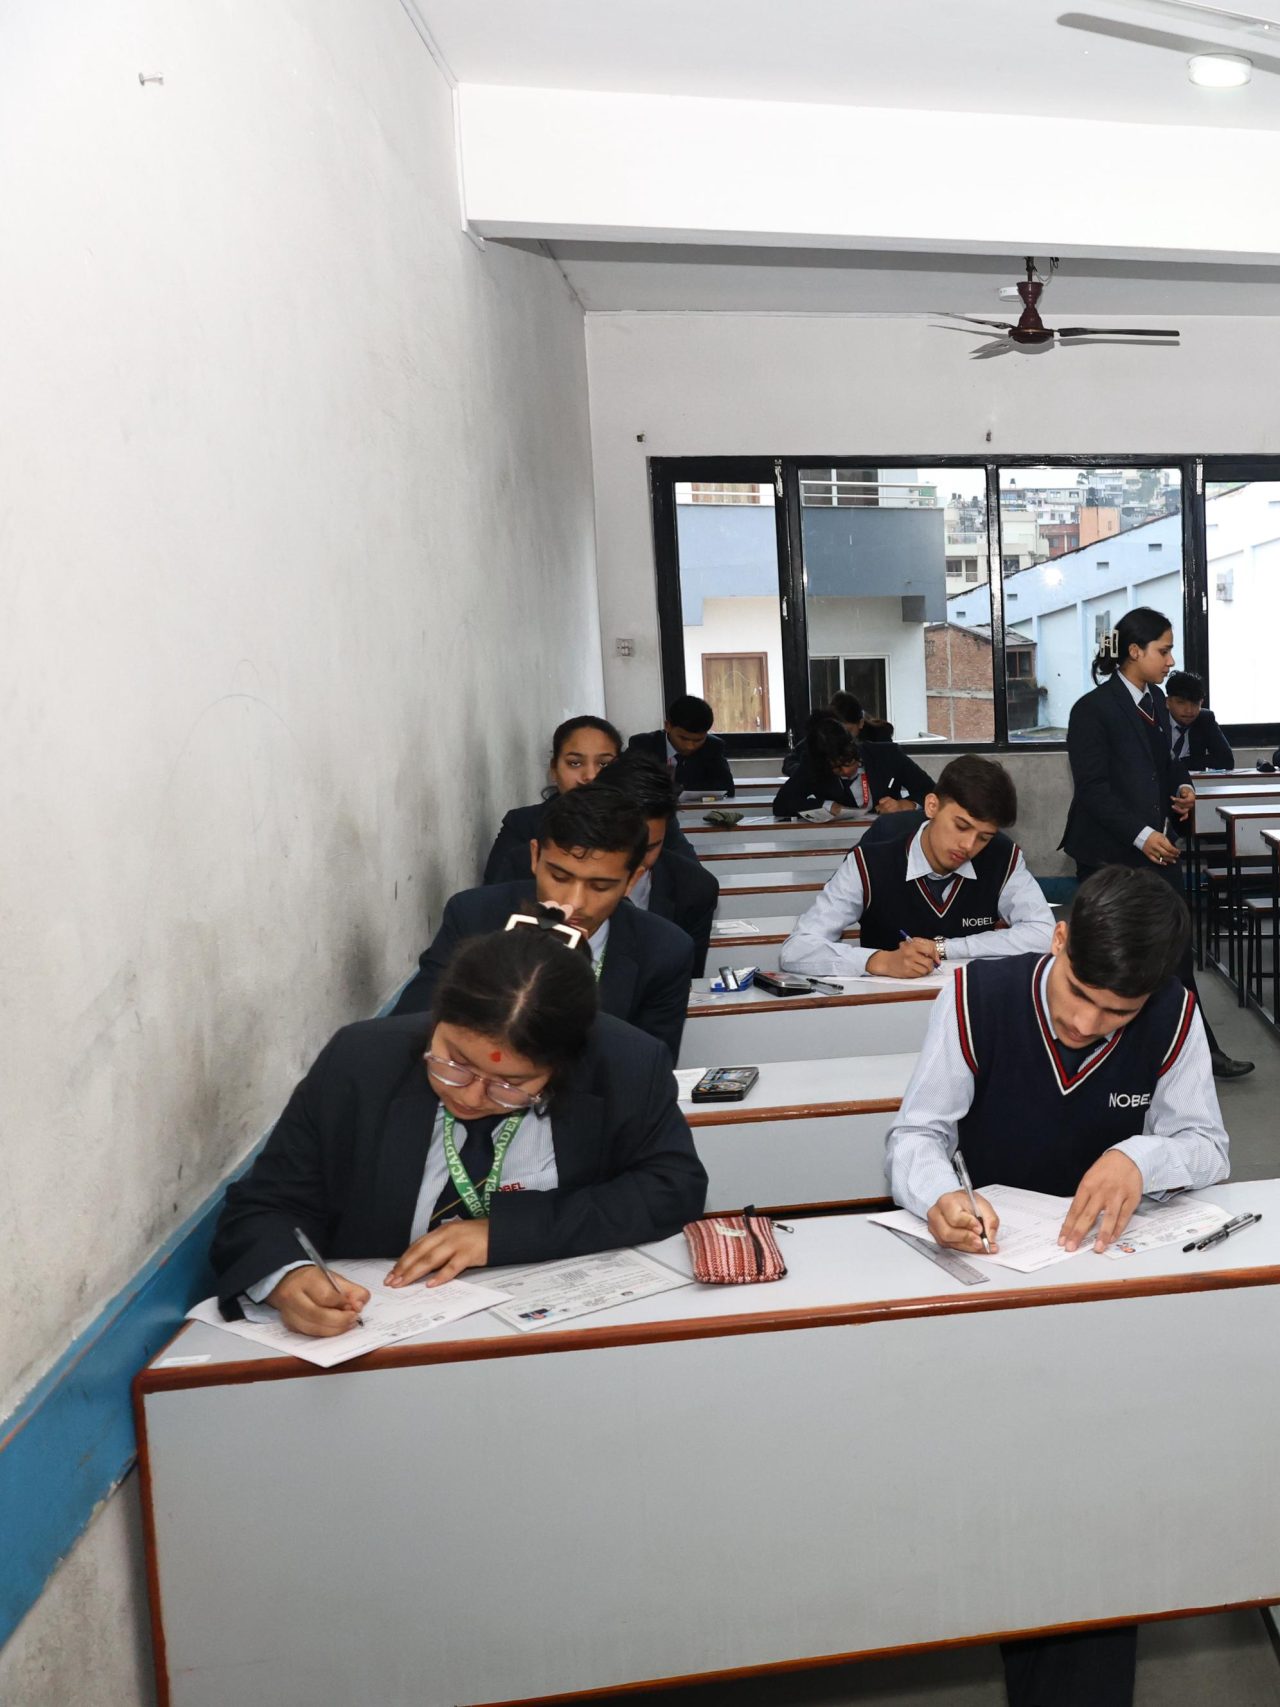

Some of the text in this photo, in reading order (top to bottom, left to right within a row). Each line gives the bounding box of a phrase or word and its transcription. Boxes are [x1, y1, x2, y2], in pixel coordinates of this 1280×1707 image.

[962, 917, 995, 928] NOBEL
[1109, 1092, 1152, 1108] NOBE
[463, 1186, 485, 1217] OBEL
